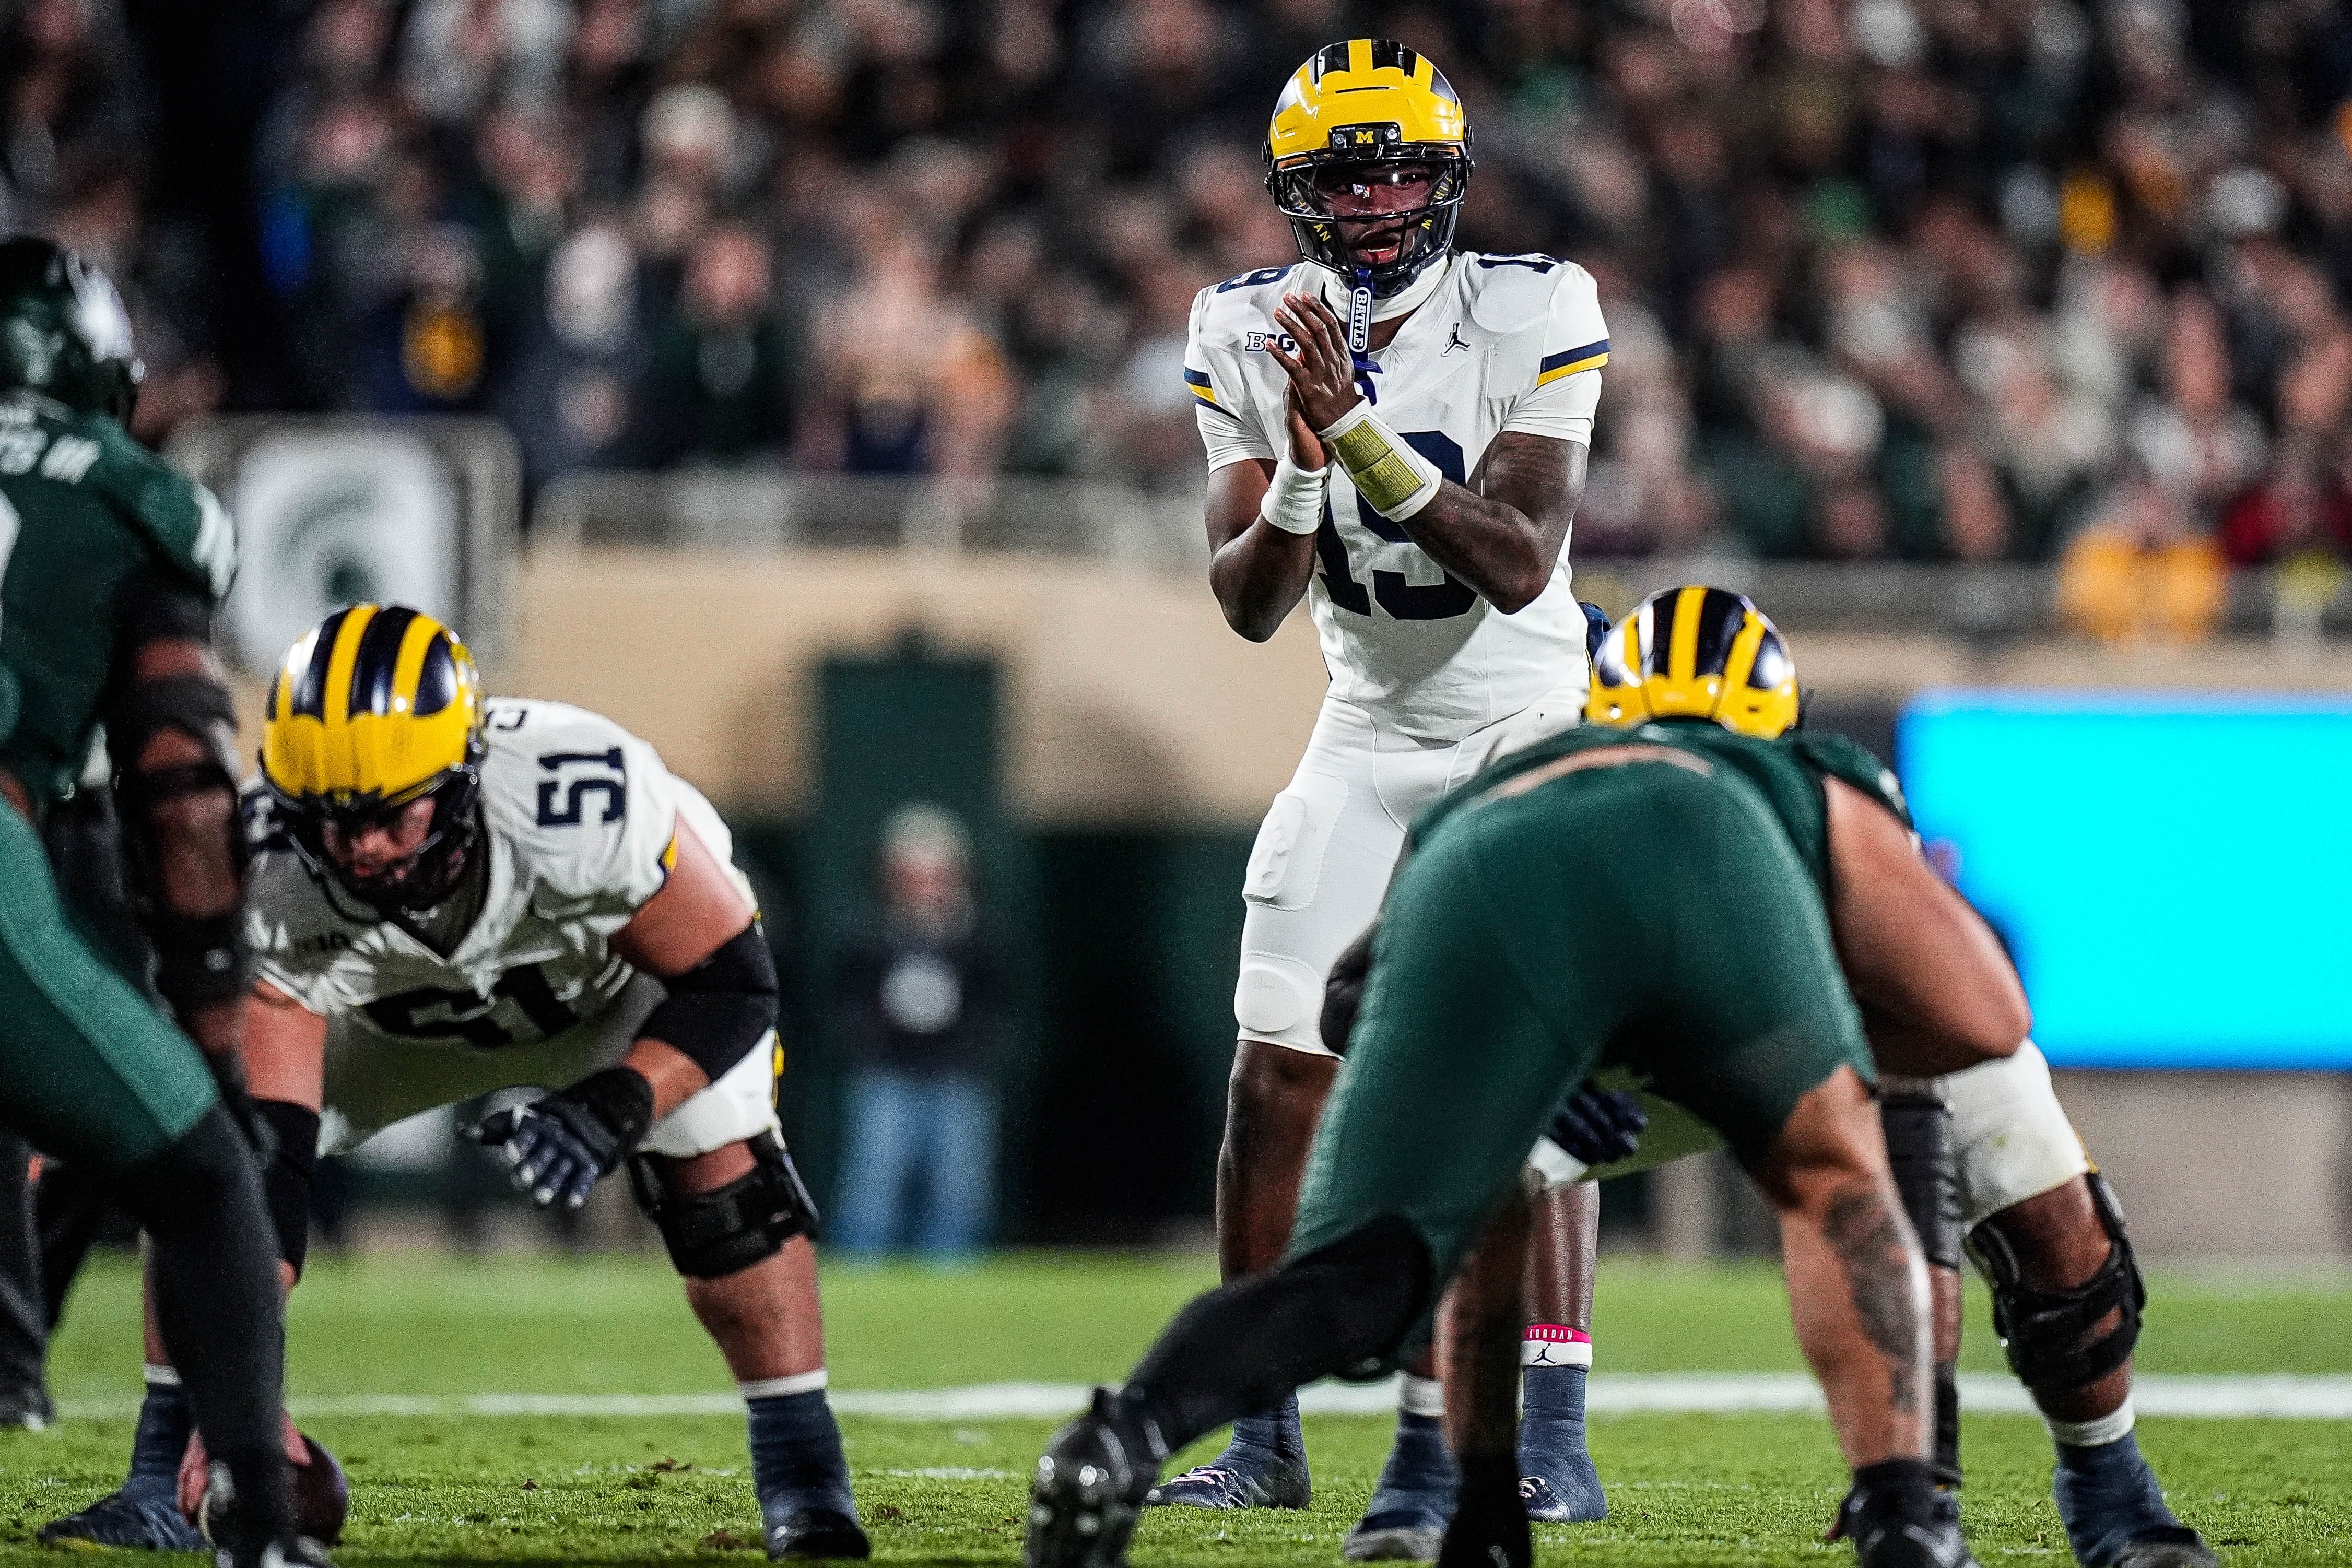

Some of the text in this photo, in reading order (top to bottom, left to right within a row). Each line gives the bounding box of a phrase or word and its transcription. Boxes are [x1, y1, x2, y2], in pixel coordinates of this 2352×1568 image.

[1356, 131, 1373, 144] M
[1353, 293, 1368, 347] BATTLE
[538, 748, 626, 827] 51
[1529, 1328, 1573, 1340] JORDAN
